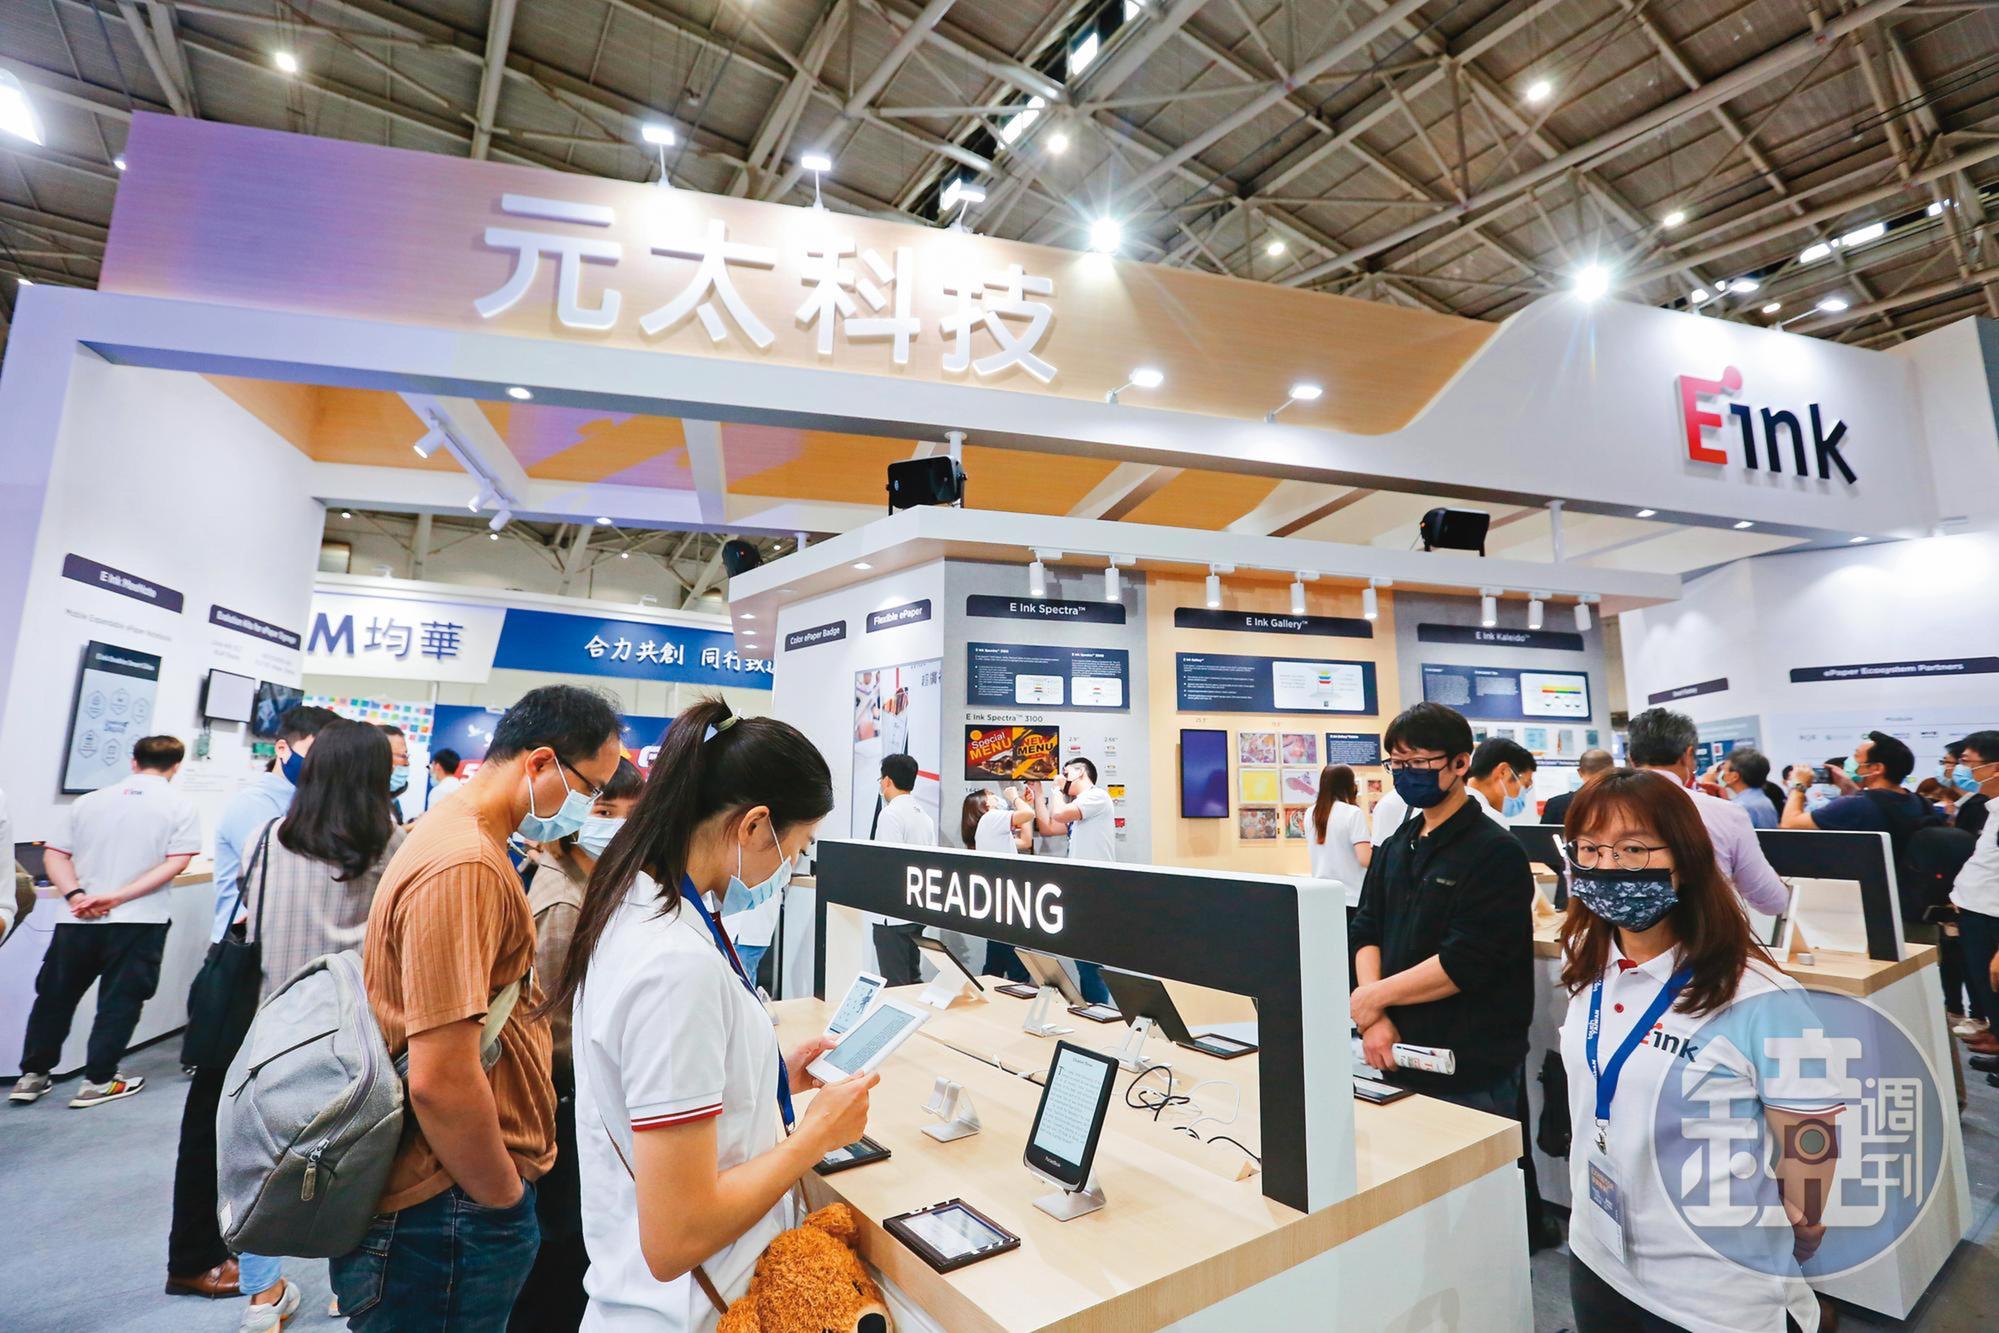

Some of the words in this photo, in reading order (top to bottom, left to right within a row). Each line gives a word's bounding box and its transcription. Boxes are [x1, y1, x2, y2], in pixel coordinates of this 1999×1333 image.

[472, 192, 1058, 384] 元太科技
[873, 612, 898, 626] Flexible
[899, 607, 923, 619] ePaper
[1009, 602, 1017, 612] E
[1020, 603, 1036, 613] Ink
[1246, 617, 1252, 626] E
[1254, 617, 1269, 627] Ink
[307, 612, 355, 654] M
[364, 616, 464, 660] 均華
[790, 635, 804, 645] Color
[804, 631, 823, 642] ePaper
[823, 627, 840, 638] Badge
[1475, 631, 1482, 640] E
[1483, 631, 1495, 640] Ink
[584, 634, 685, 665] 合力共創
[701, 647, 776, 674] 同行致
[1823, 668, 1859, 677] ePaper
[1860, 665, 1916, 675] Ecosystem
[1917, 663, 1965, 672] Partners
[969, 736, 1012, 760] MENU
[971, 731, 1006, 749] Special
[1017, 743, 1054, 755] MENU
[905, 865, 1064, 935] READING
